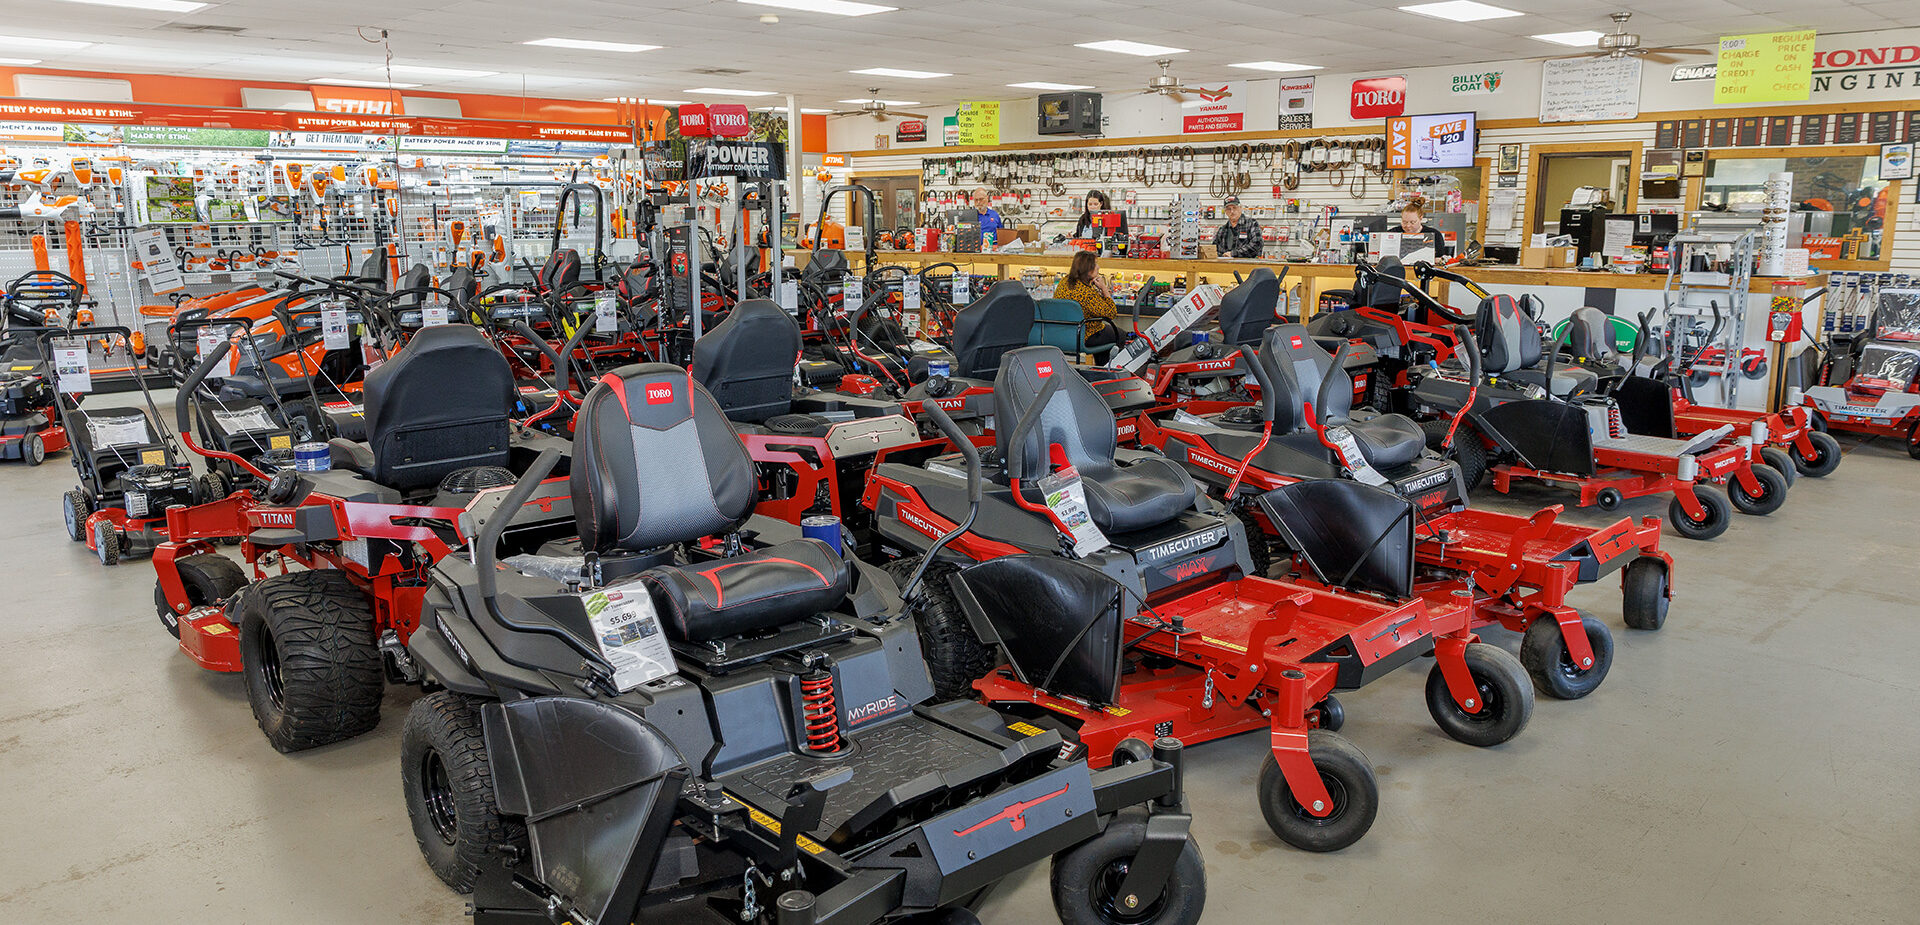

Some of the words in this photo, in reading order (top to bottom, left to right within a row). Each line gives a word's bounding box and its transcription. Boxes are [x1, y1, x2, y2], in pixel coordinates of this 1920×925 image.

[1772, 33, 1815, 43] REGULAR
[1777, 44, 1807, 52] PRICE
[1721, 50, 1760, 59] CHARGE
[1812, 45, 1920, 69] OND
[1674, 66, 1718, 79] SNAPP
[1721, 69, 1755, 77] CREDIT
[1775, 64, 1801, 72] CASH
[1452, 74, 1482, 84] BILLY
[1813, 70, 1920, 92] NGINE
[1281, 83, 1313, 92] Kawasaki
[1452, 83, 1482, 92] GOAT
[1721, 86, 1748, 94] DEBIT
[1772, 83, 1805, 91] CHECK
[1354, 89, 1400, 107] TORO
[0, 106, 27, 114] TTERY
[29, 106, 66, 115] POWER.
[68, 108, 94, 116] MADE
[298, 118, 330, 126] BATTERY
[331, 119, 360, 127] POWER.
[360, 120, 380, 128] MADE
[680, 114, 702, 126] TORO
[713, 114, 744, 126] TORO
[1433, 121, 1462, 136] SAVE
[306, 134, 321, 142] GET
[322, 134, 342, 143] THEM
[344, 135, 363, 144] NOW!
[1442, 133, 1460, 142] $20
[1392, 120, 1406, 166] SAVE
[708, 146, 769, 164] POWER
[1196, 361, 1231, 370] TITAN
[648, 388, 672, 399] TORO
[940, 400, 962, 408] TAN
[1834, 405, 1888, 414] TIMECUTTER
[1117, 424, 1135, 436] TORO
[1404, 472, 1446, 492] TIMECUTTER
[1422, 491, 1444, 508] MAX
[261, 513, 293, 524] TITAN
[1150, 531, 1214, 560] TIMECUTTER
[1176, 557, 1208, 582] MAX
